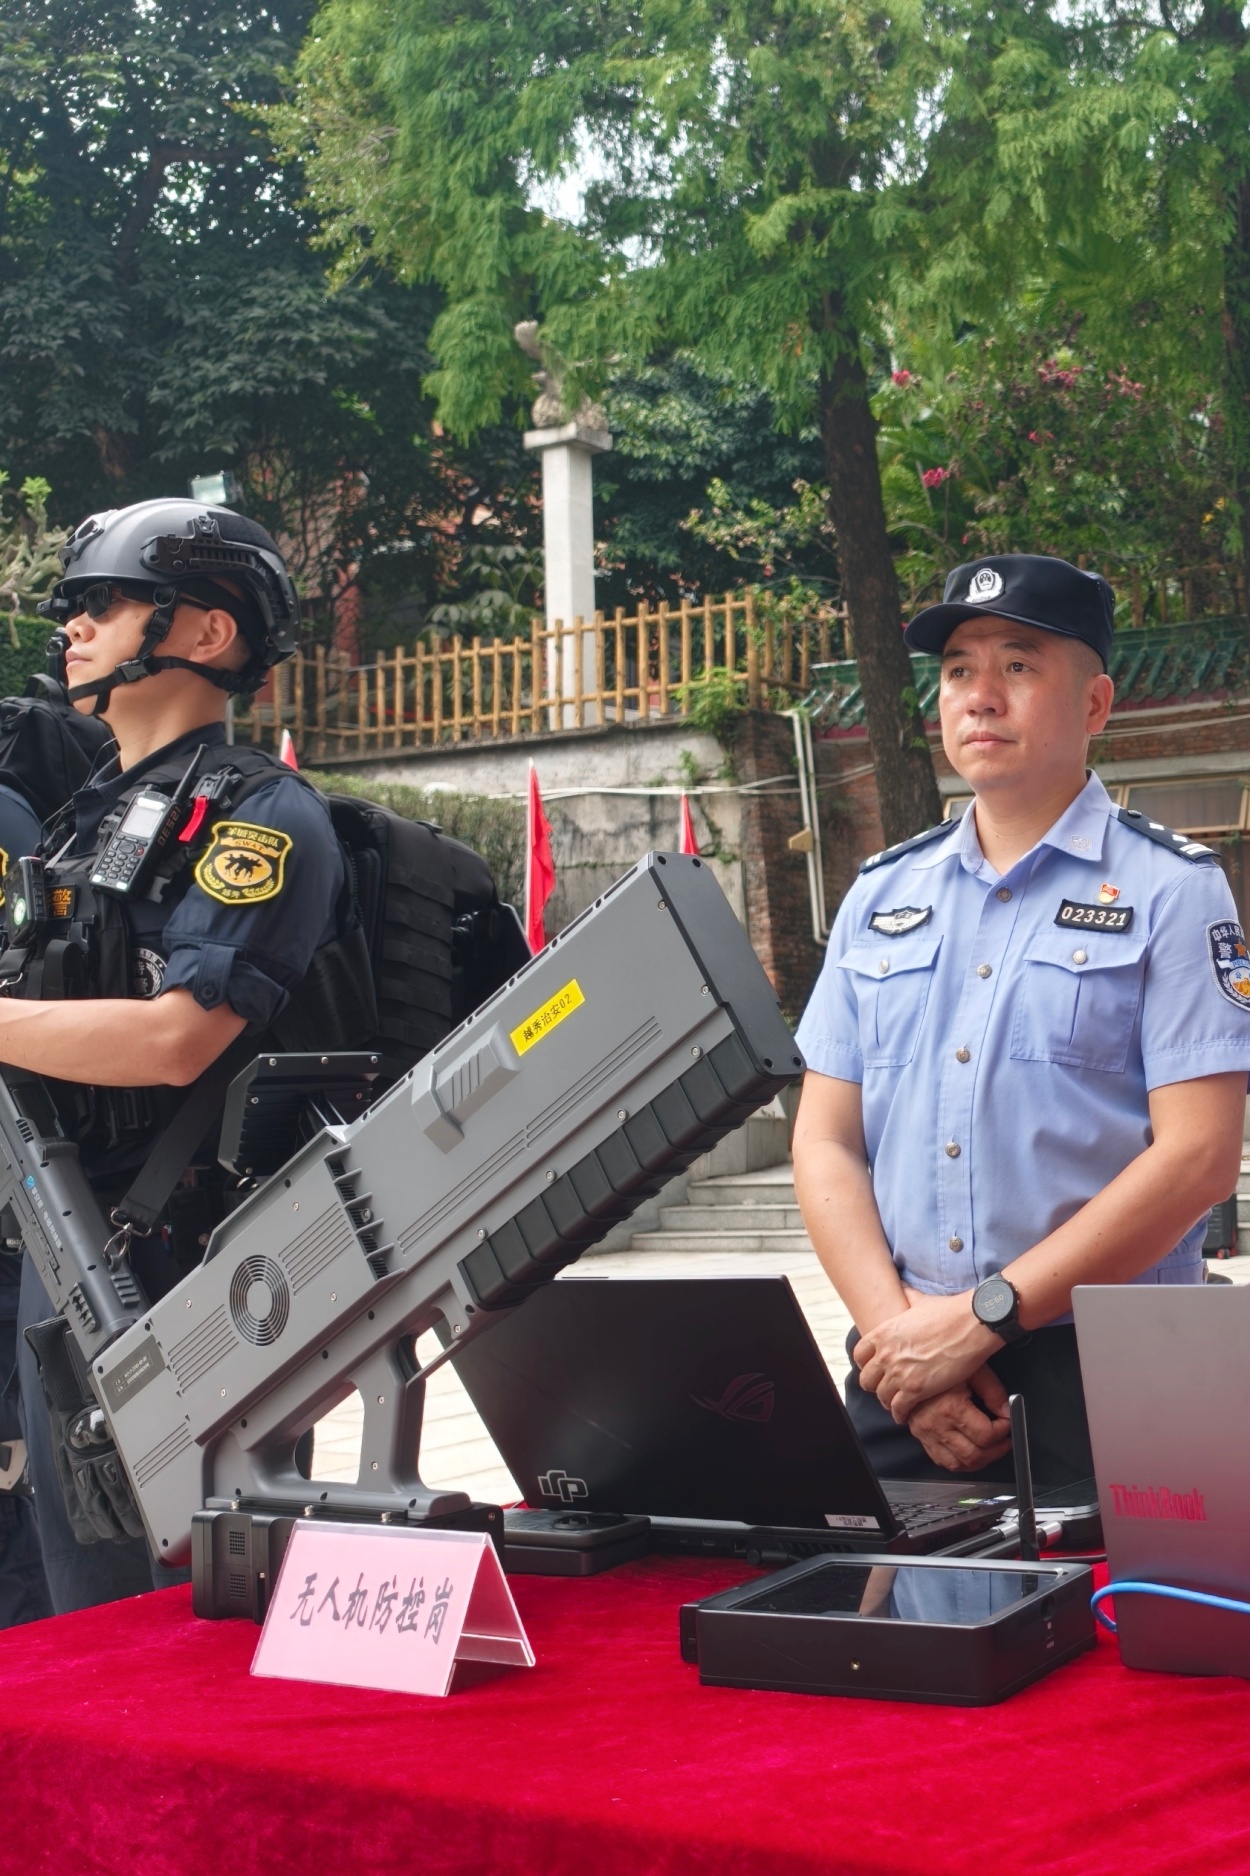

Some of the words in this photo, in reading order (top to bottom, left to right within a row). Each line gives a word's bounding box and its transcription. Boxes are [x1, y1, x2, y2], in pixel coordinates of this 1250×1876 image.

[1061, 907, 1127, 926] 023321
[1110, 1484, 1207, 1521] ThinkBook
[289, 1572, 453, 1645] 无人机防控岗
